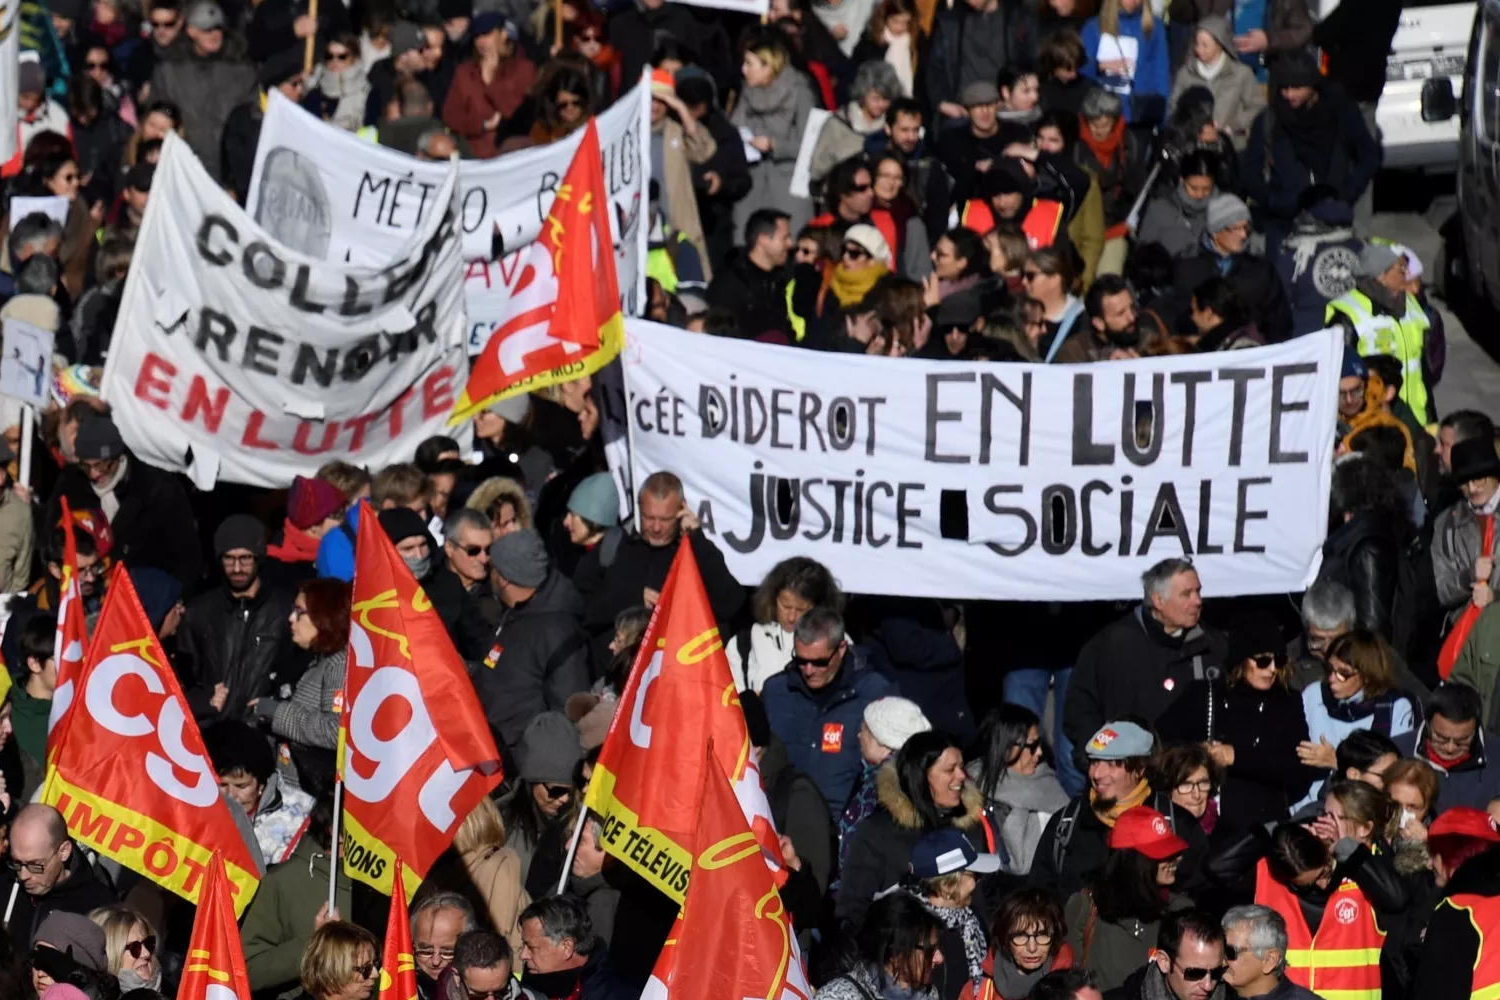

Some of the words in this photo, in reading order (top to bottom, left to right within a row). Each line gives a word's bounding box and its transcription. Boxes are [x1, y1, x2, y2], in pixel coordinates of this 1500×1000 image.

[134, 351, 231, 434] EN
[241, 365, 455, 456] LUTTE
[924, 371, 1033, 466] EN
[1072, 362, 1318, 467] LUTTE
[55, 791, 241, 902] IMPÔT
